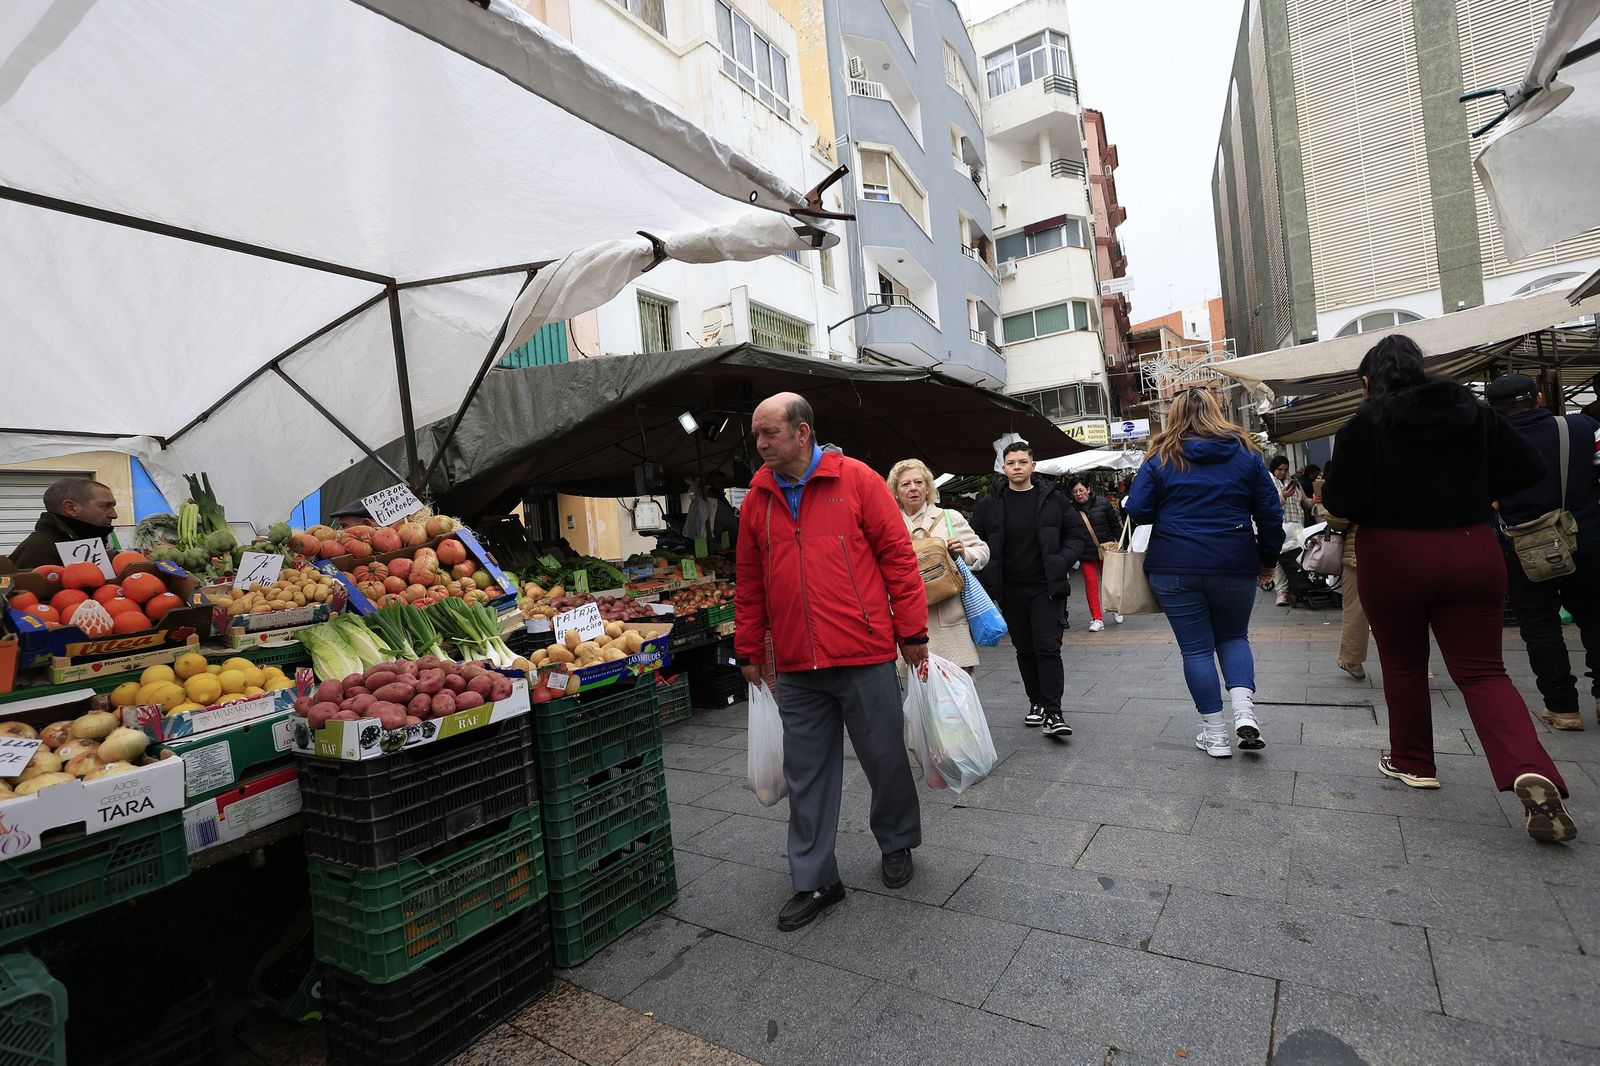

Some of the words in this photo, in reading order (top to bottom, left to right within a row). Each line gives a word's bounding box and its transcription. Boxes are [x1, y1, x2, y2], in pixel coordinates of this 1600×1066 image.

[104, 657, 132, 666] Hannah
[211, 702, 257, 720] WARAKKO
[458, 715, 480, 729] RAF
[0, 739, 39, 749] LLA
[321, 743, 337, 755] RAF
[113, 779, 139, 792] AJOS
[101, 785, 151, 805] CEBOLLAS
[97, 796, 155, 823] TARA
